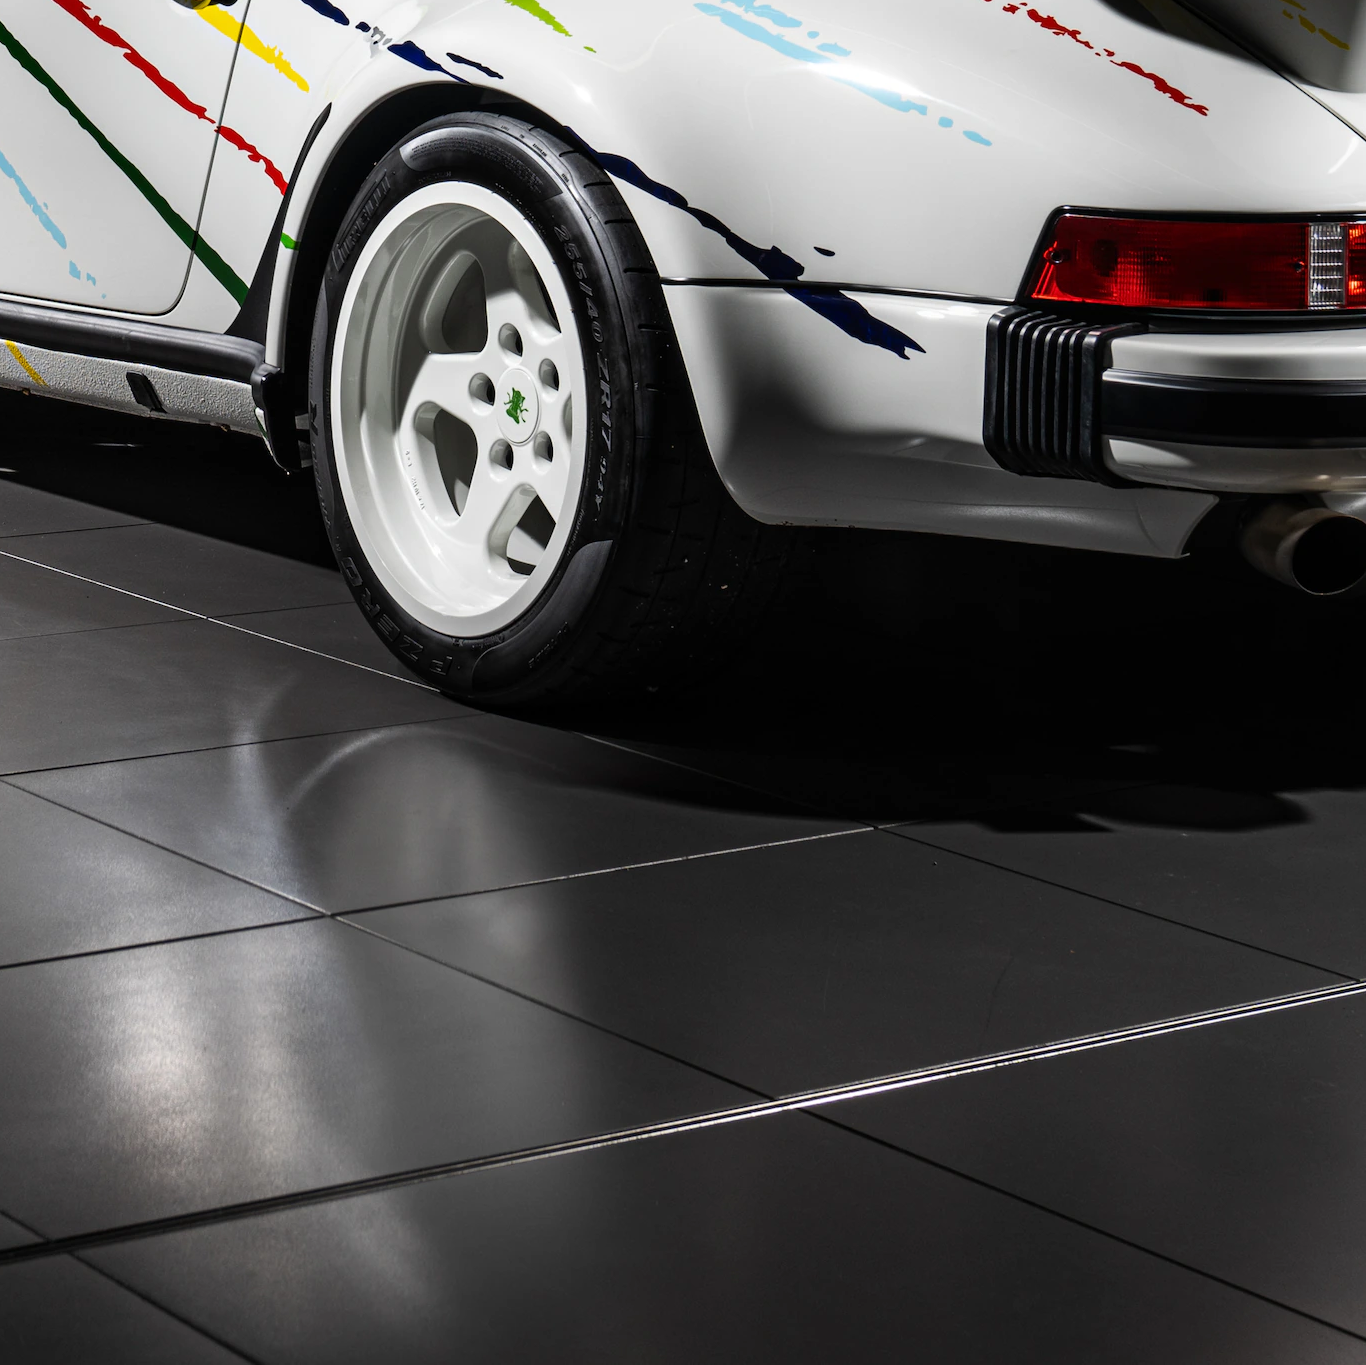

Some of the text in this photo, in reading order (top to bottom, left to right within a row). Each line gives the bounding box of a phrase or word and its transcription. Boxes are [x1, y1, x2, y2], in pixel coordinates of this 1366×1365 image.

[553, 224, 604, 343] 255/40
[596, 351, 613, 453] ZR17
[340, 556, 424, 663] ZERO
